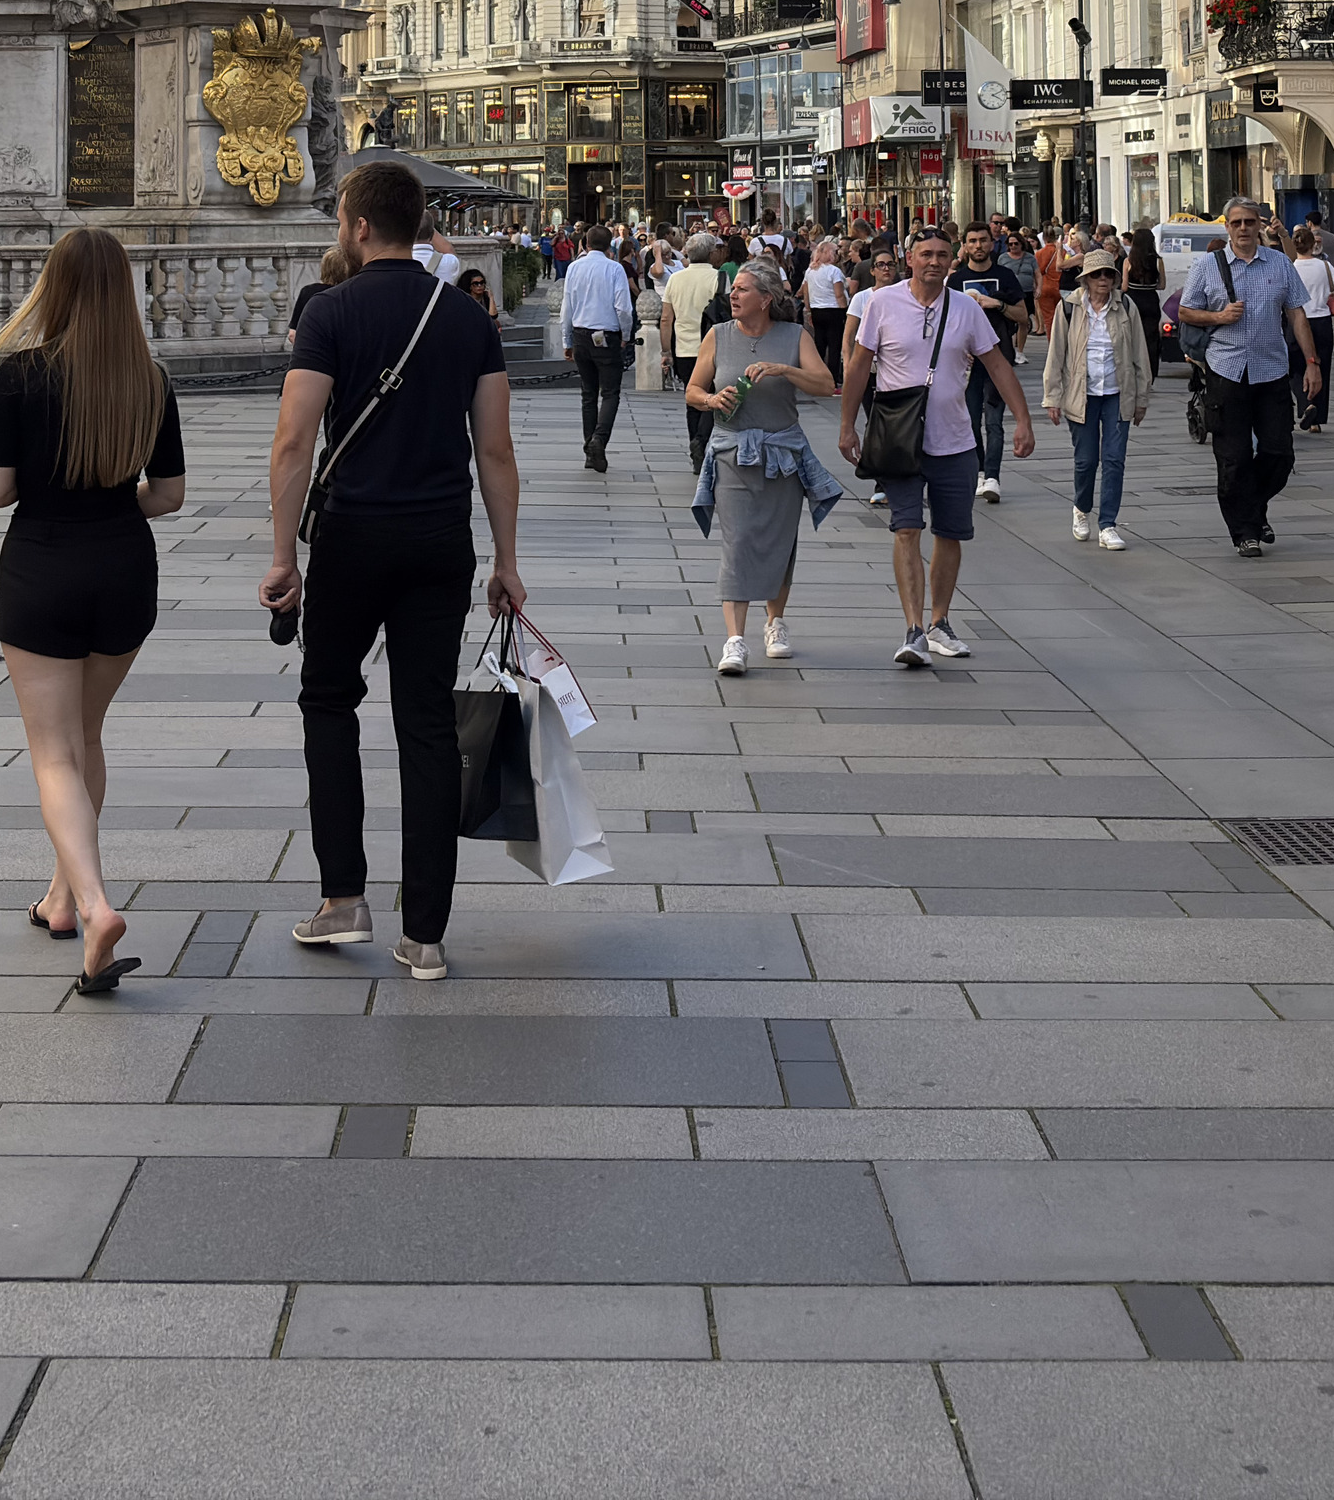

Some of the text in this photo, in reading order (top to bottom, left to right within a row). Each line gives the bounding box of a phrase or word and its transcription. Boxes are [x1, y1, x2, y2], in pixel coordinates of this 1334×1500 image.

[925, 81, 966, 89] LIEBES
[1033, 83, 1063, 97] IWC
[901, 126, 937, 134] FRIGO
[969, 129, 1014, 143] LISKA
[732, 166, 754, 178] SOUVENIRS
